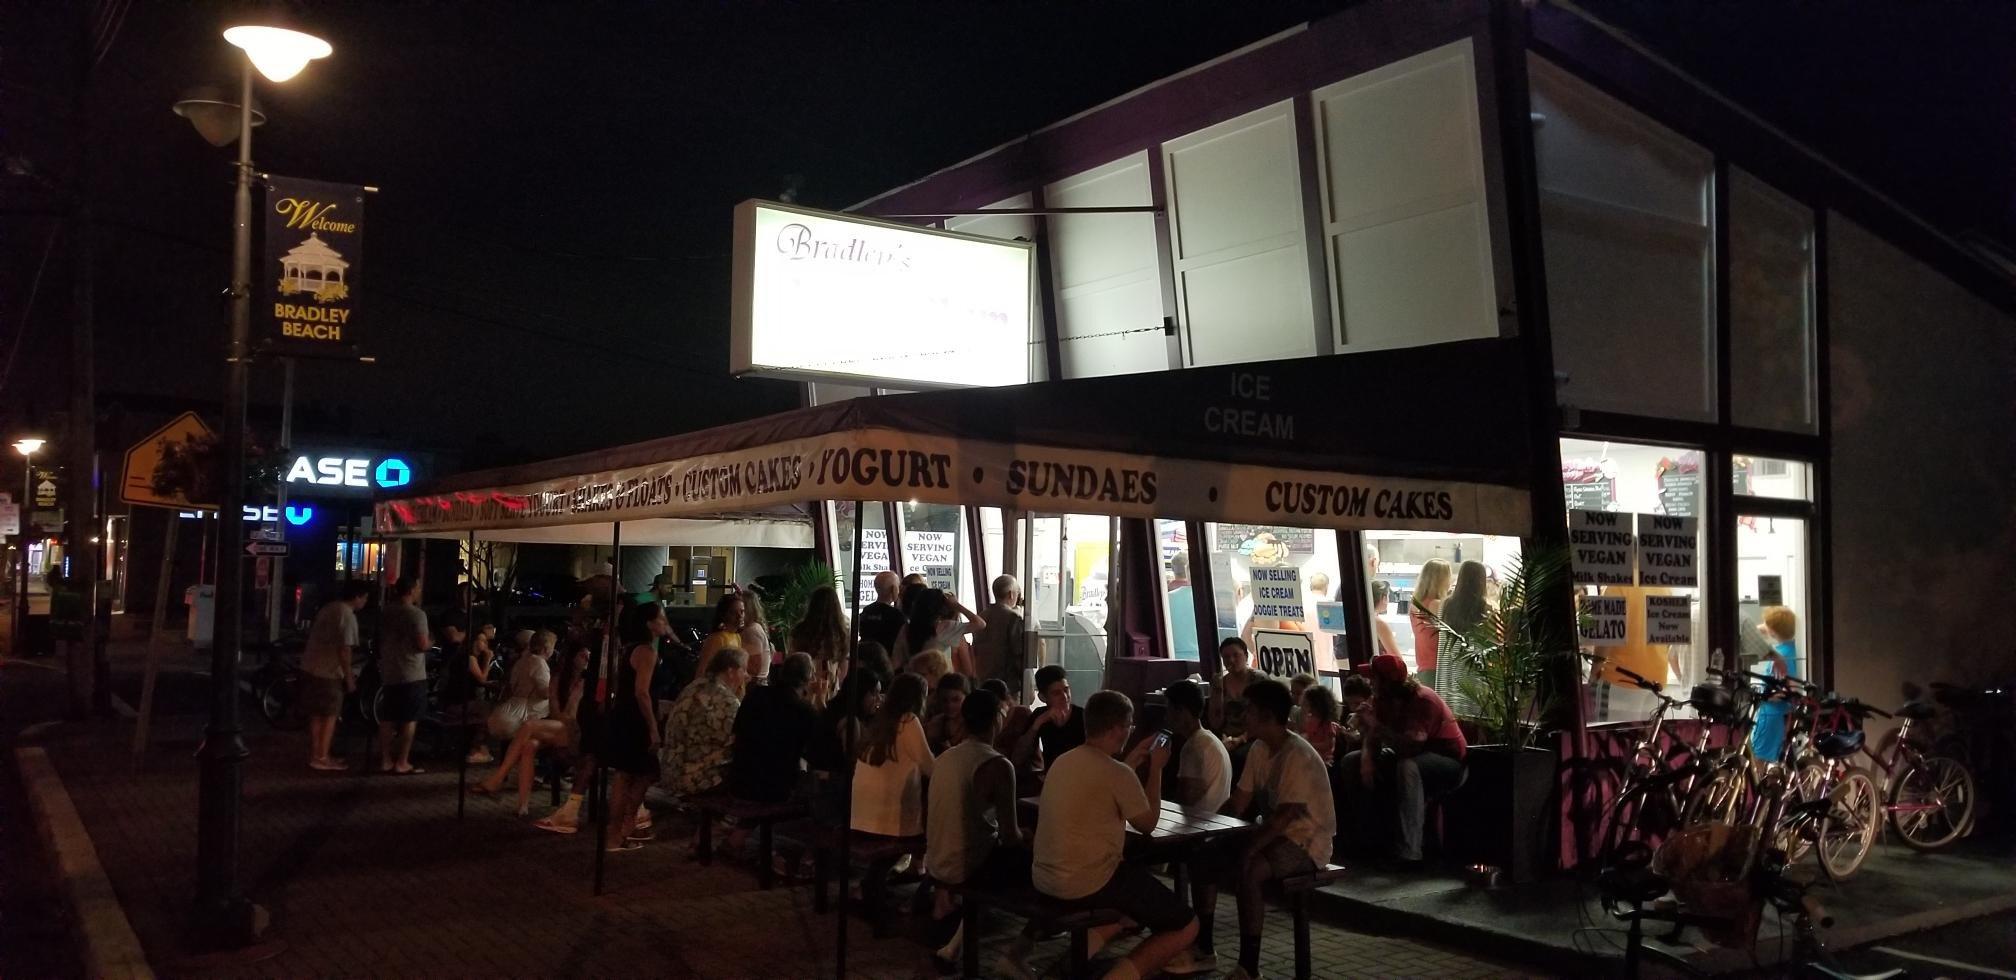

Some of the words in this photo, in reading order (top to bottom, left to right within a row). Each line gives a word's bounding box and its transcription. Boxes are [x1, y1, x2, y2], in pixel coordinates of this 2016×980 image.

[275, 198, 355, 232] Welcome
[274, 303, 349, 324] BRADLEY
[282, 322, 340, 340] BEACH
[1231, 372, 1271, 400] ICE
[1204, 407, 1295, 440] CREAM
[572, 483, 613, 513] SHAKES
[626, 475, 672, 508] FLOATS
[682, 463, 741, 501] CUSTOM
[745, 455, 801, 496] CAKES
[816, 447, 950, 488] YOGURT
[1006, 460, 1157, 504] SUNDAES
[1265, 480, 1370, 517] CUSTOM
[1374, 489, 1453, 520] CAKES
[1585, 512, 1618, 526] NOW
[1653, 516, 1684, 530] NOW
[918, 533, 942, 541] NOW
[1571, 530, 1633, 546] SERVING
[1640, 534, 1696, 549] SERVING
[907, 543, 952, 552] SERVING
[861, 552, 888, 560] VEGA
[912, 554, 948, 562] VEGAN
[1578, 549, 1626, 565] VEGAN
[1646, 553, 1691, 568] VEGAN
[1253, 569, 1268, 580] NOW
[1269, 570, 1296, 581] SELLING
[1640, 572, 1657, 584] Ice
[1259, 587, 1269, 598] ICE
[1272, 588, 1294, 599] CREAM
[1254, 605, 1278, 616] DOGGIE
[1279, 606, 1304, 617] TREATS
[1604, 600, 1626, 615] MADE
[1647, 609, 1659, 618] Ice
[1260, 645, 1312, 677] OPEN
